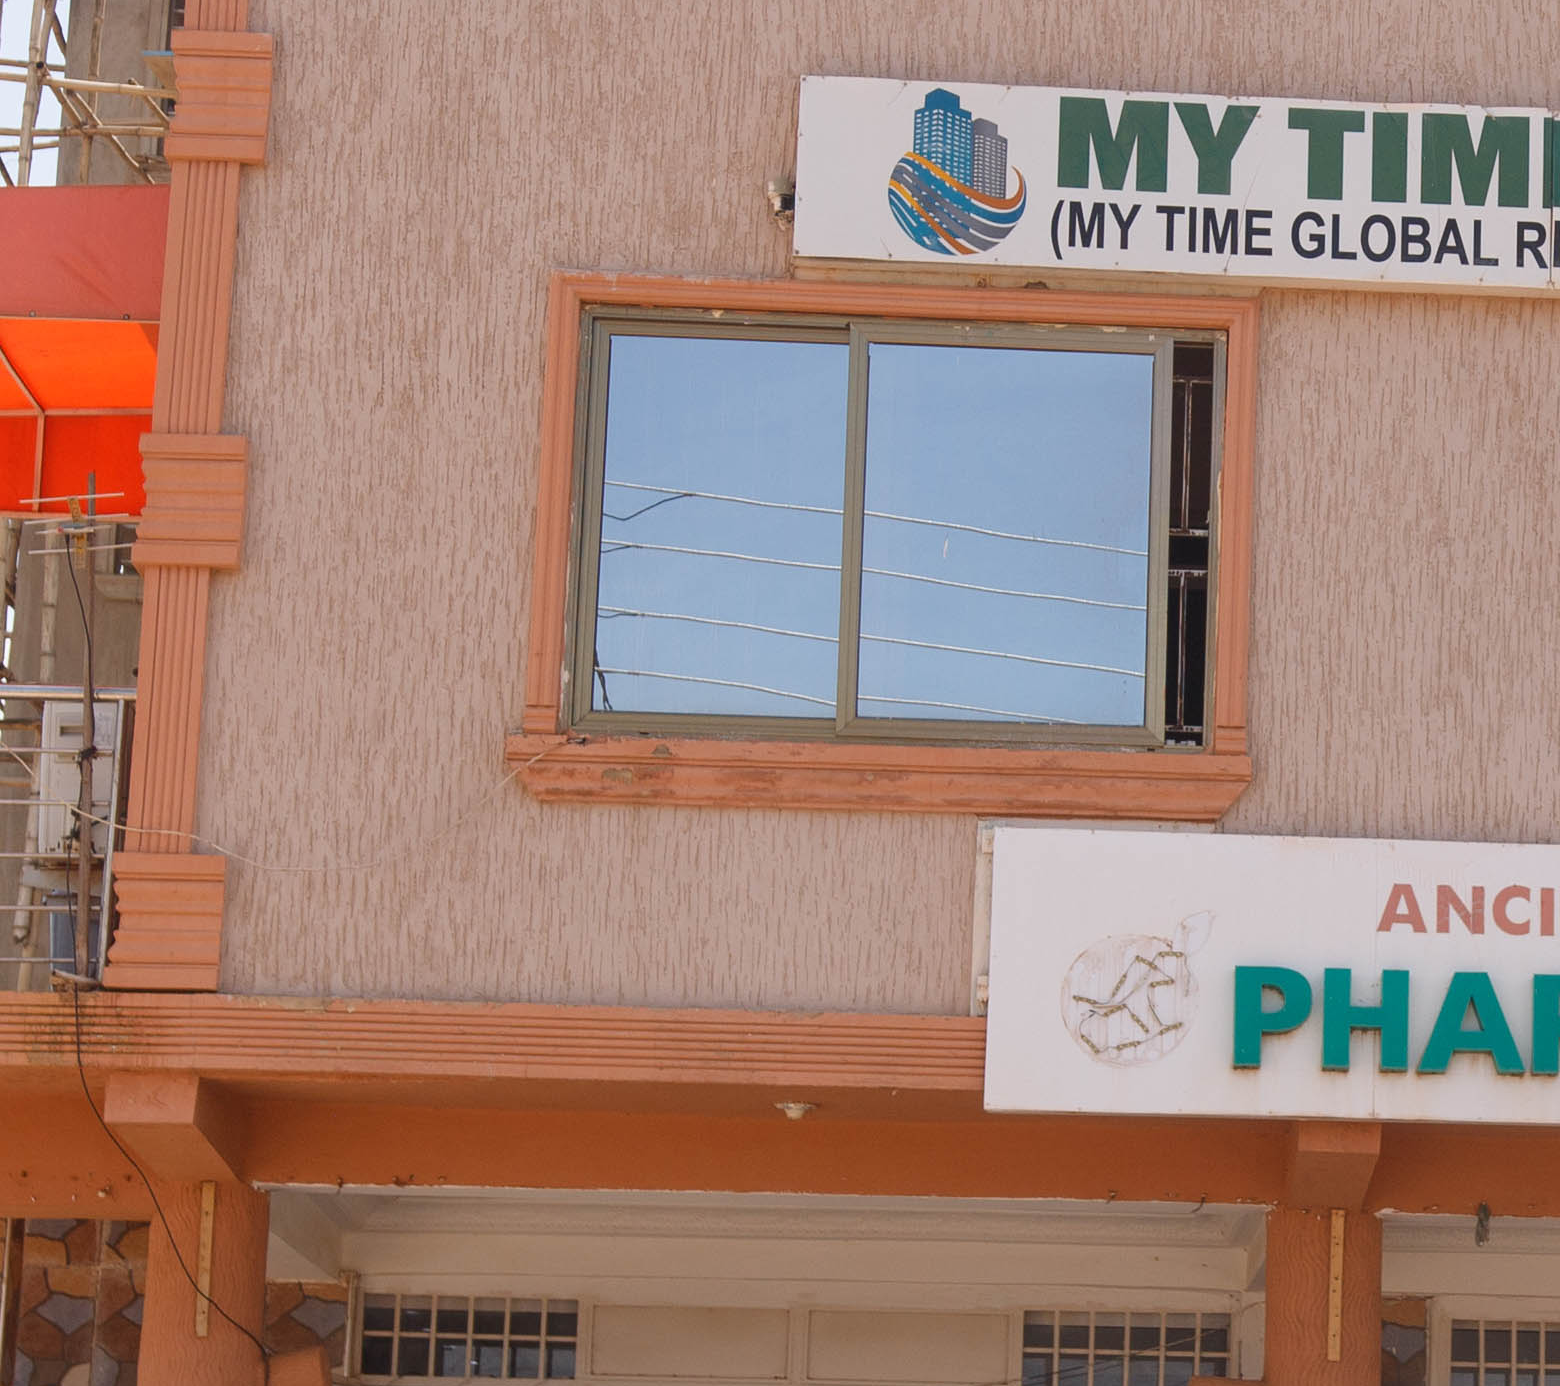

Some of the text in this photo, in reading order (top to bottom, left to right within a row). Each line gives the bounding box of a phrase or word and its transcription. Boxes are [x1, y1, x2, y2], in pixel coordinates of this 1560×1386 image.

[1058, 97, 1260, 195] MY
[1051, 200, 1142, 261] (MY
[1156, 205, 1273, 257] TIME
[1291, 212, 1499, 267] GLOBAL
